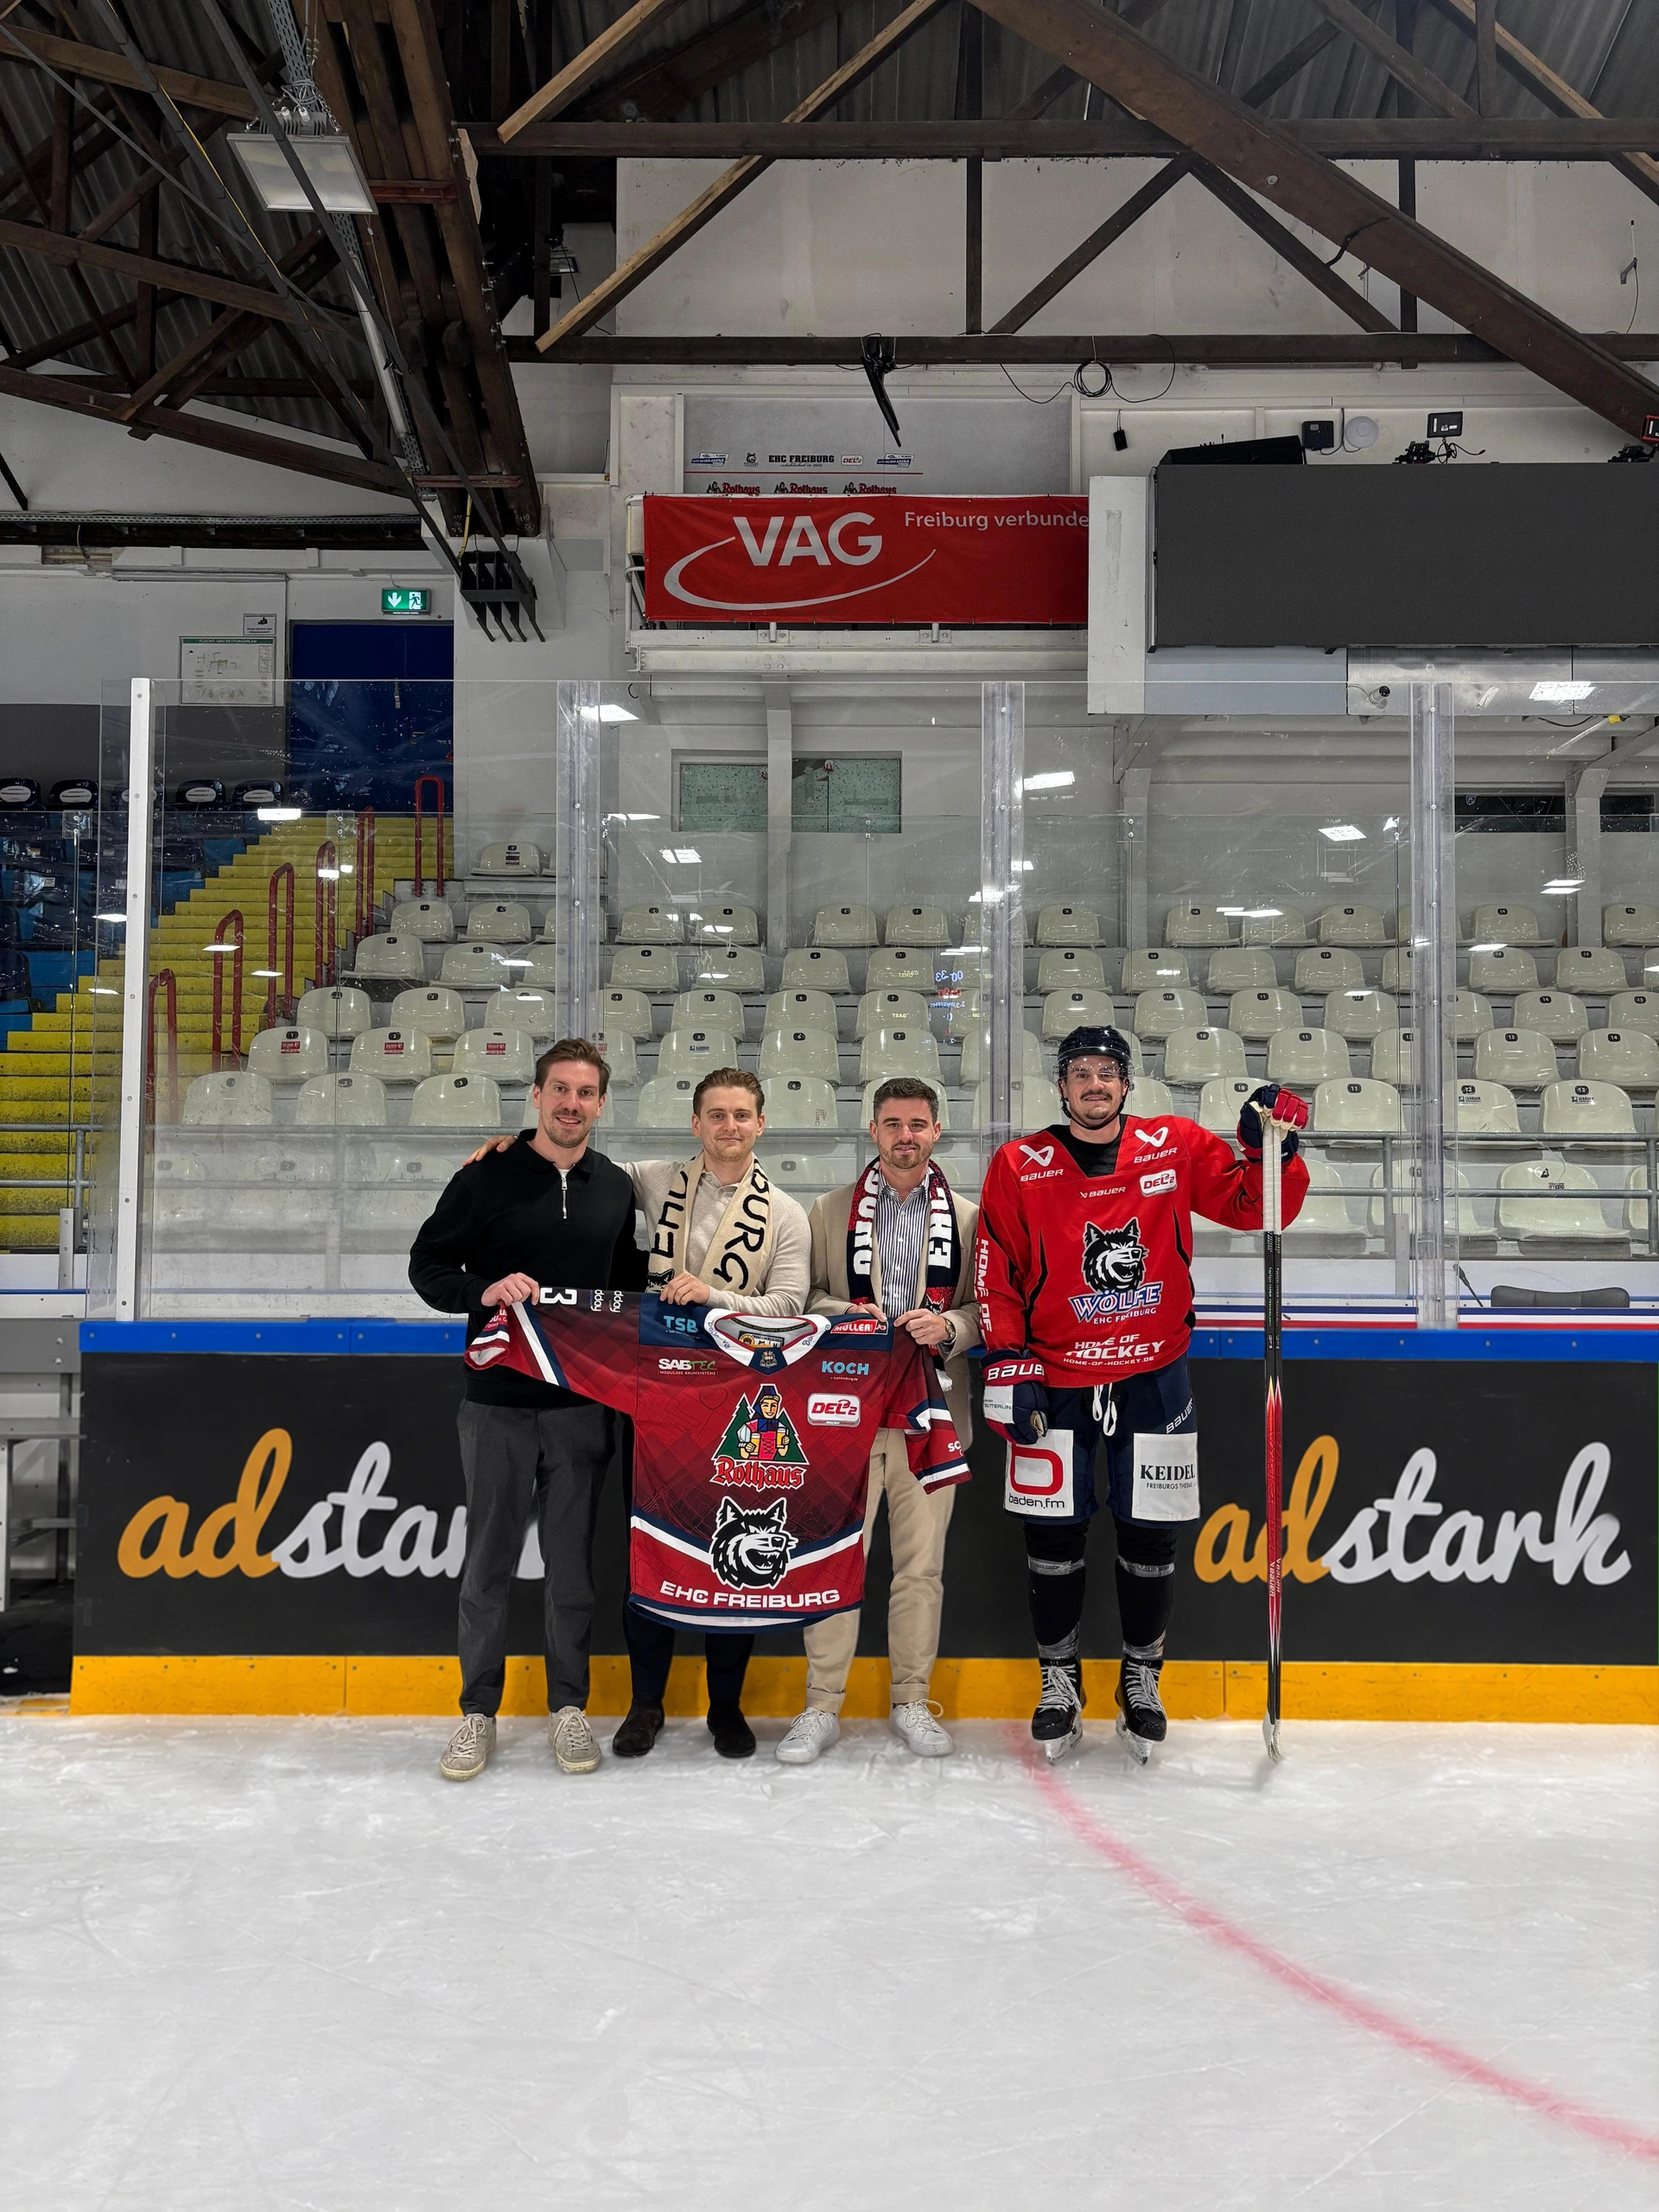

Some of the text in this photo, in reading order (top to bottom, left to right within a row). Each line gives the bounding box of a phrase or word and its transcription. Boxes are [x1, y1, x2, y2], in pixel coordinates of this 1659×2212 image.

[768, 454, 835, 463] EHC FREIBURG
[721, 481, 761, 494] Rothaus
[789, 482, 829, 494] Rothaus
[858, 482, 897, 494] Rothaus
[905, 511, 989, 531] Freiburg
[733, 512, 883, 567] VAG
[1134, 1147, 1178, 1164] BAUER
[1020, 1168, 1064, 1182] BAUER
[1143, 1173, 1175, 1190] DEL2
[1088, 1186, 1126, 1198] BAUER
[977, 1239, 989, 1298] HOME
[590, 1289, 605, 1312] dday
[609, 1290, 624, 1313] dday
[1068, 1281, 1163, 1323] WÖLFE
[663, 1315, 699, 1333] TSB
[981, 1303, 993, 1332] OF
[1093, 1307, 1157, 1325] EHC FREIBURG
[834, 1323, 871, 1332] MÜLLER
[1119, 1333, 1141, 1344] OF
[1065, 1339, 1166, 1359] HOCKEY
[658, 1357, 718, 1370] SABTEC
[821, 1360, 870, 1376] KOCH
[1063, 1356, 1154, 1366] HOME-OF-HOCKEY.DE
[811, 1399, 857, 1416] DEL2
[710, 1456, 807, 1492] Rothaus
[1140, 1464, 1196, 1481] KEIDEL
[118, 1427, 545, 1580] adsta
[1008, 1492, 1065, 1510] baden.fm
[1194, 1434, 1632, 1586] adstark
[660, 1580, 841, 1608] EHC FREIBURG
